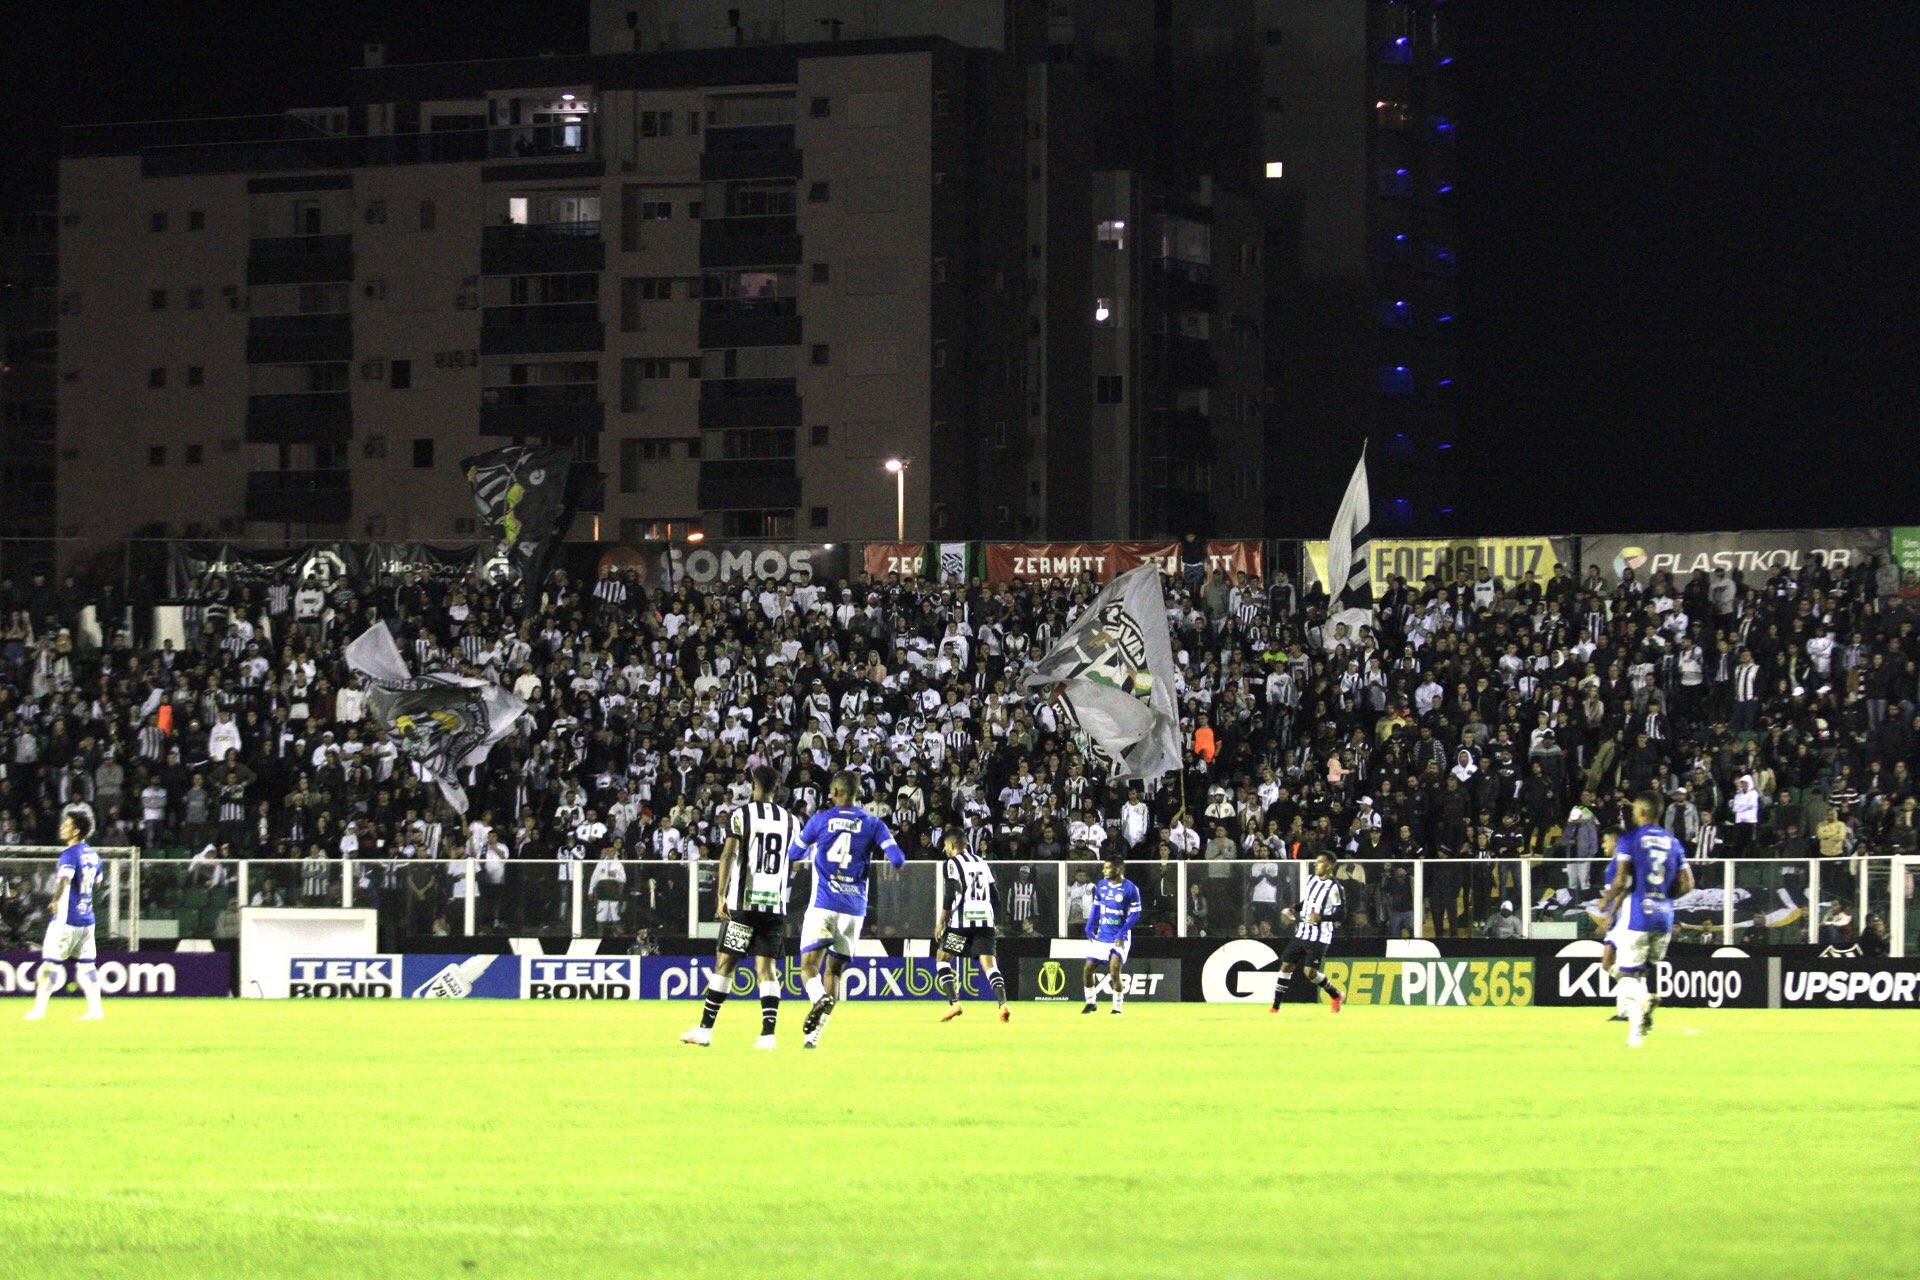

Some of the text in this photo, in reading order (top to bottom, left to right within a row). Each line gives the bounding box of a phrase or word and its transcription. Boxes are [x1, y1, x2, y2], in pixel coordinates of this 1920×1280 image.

[660, 549, 813, 583] SOMOS
[1013, 556, 1105, 574] ZERMATT
[1650, 549, 1851, 574] PLASTKOLOR
[1040, 578, 1080, 589] PIZA
[755, 832, 782, 875] 18
[826, 831, 853, 869] 4
[1647, 848, 1668, 885] 3
[0, 960, 176, 993] aco.om
[291, 961, 390, 979] TEK
[535, 962, 625, 980] TEK
[660, 956, 802, 1000] pixbt
[1092, 973, 1164, 995] XBET
[1656, 960, 1742, 1008] Bongo
[290, 983, 392, 998] BOND
[529, 983, 631, 999] BOND
[1784, 971, 1920, 1002] UPSPOR
